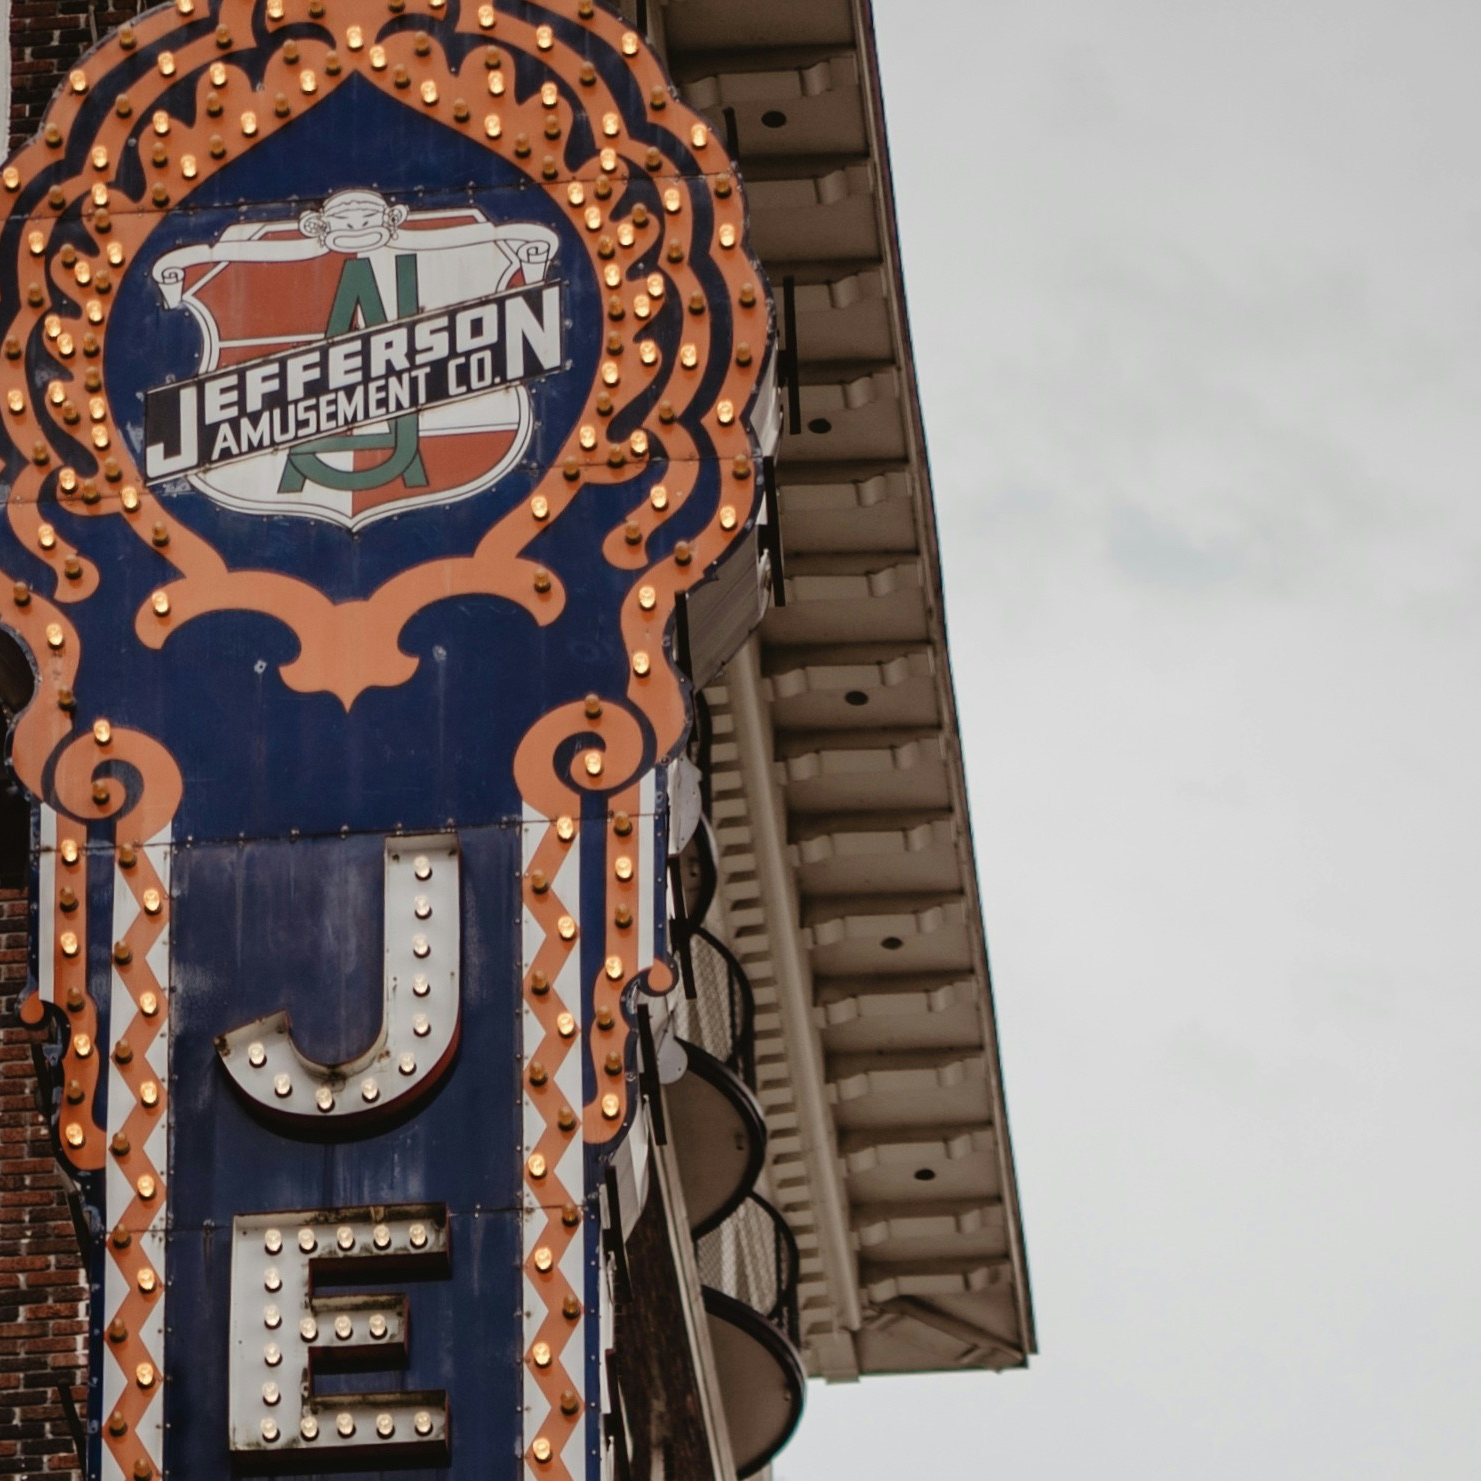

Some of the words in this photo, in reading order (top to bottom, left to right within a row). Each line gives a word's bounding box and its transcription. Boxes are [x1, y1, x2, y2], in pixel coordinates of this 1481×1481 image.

[145, 284, 561, 479] JEFFERSON
[211, 365, 431, 461] AMUSEMENT
[447, 350, 501, 396] CO.
